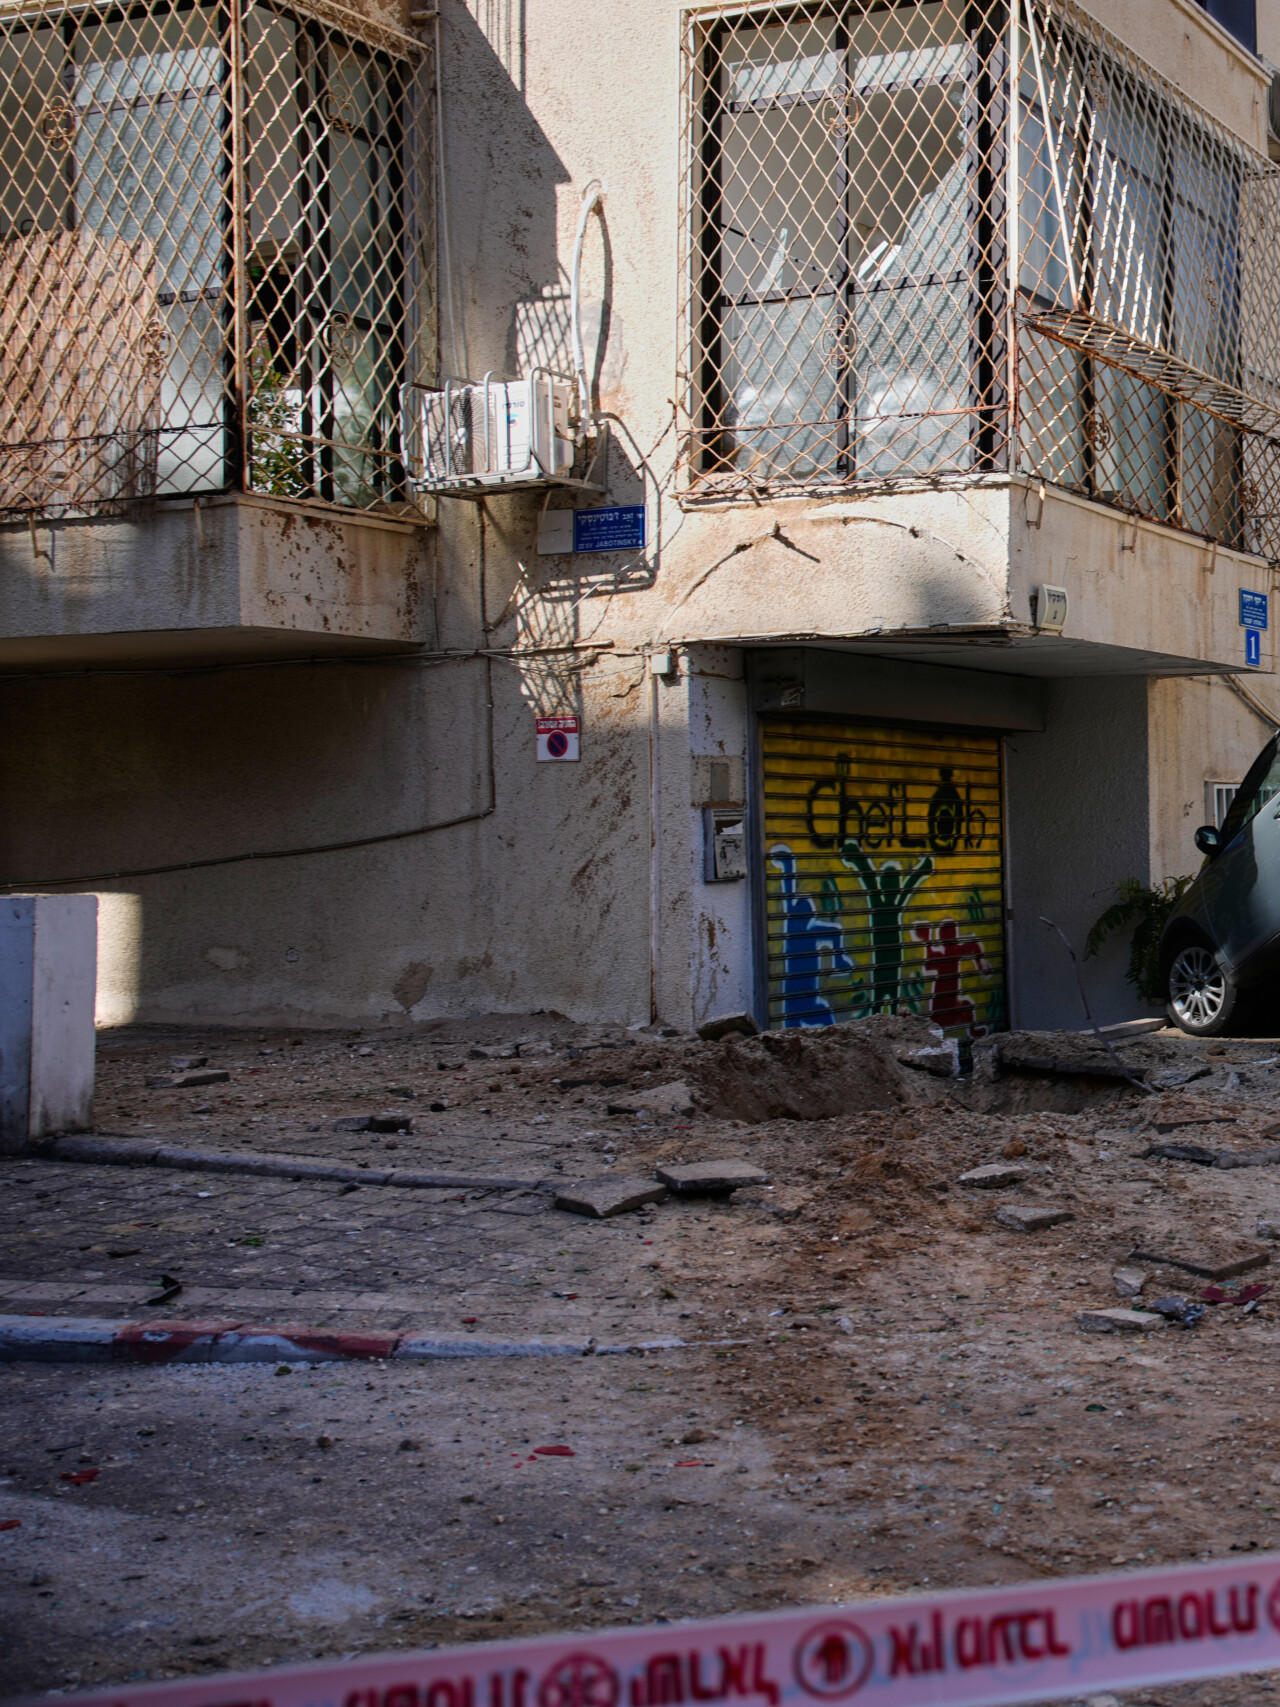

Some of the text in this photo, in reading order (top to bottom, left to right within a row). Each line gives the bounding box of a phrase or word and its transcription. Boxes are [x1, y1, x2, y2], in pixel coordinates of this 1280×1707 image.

[595, 538, 637, 549] JABOTINSKY
[1249, 635, 1257, 660] 1
[1112, 1581, 1258, 1651] משטרת
